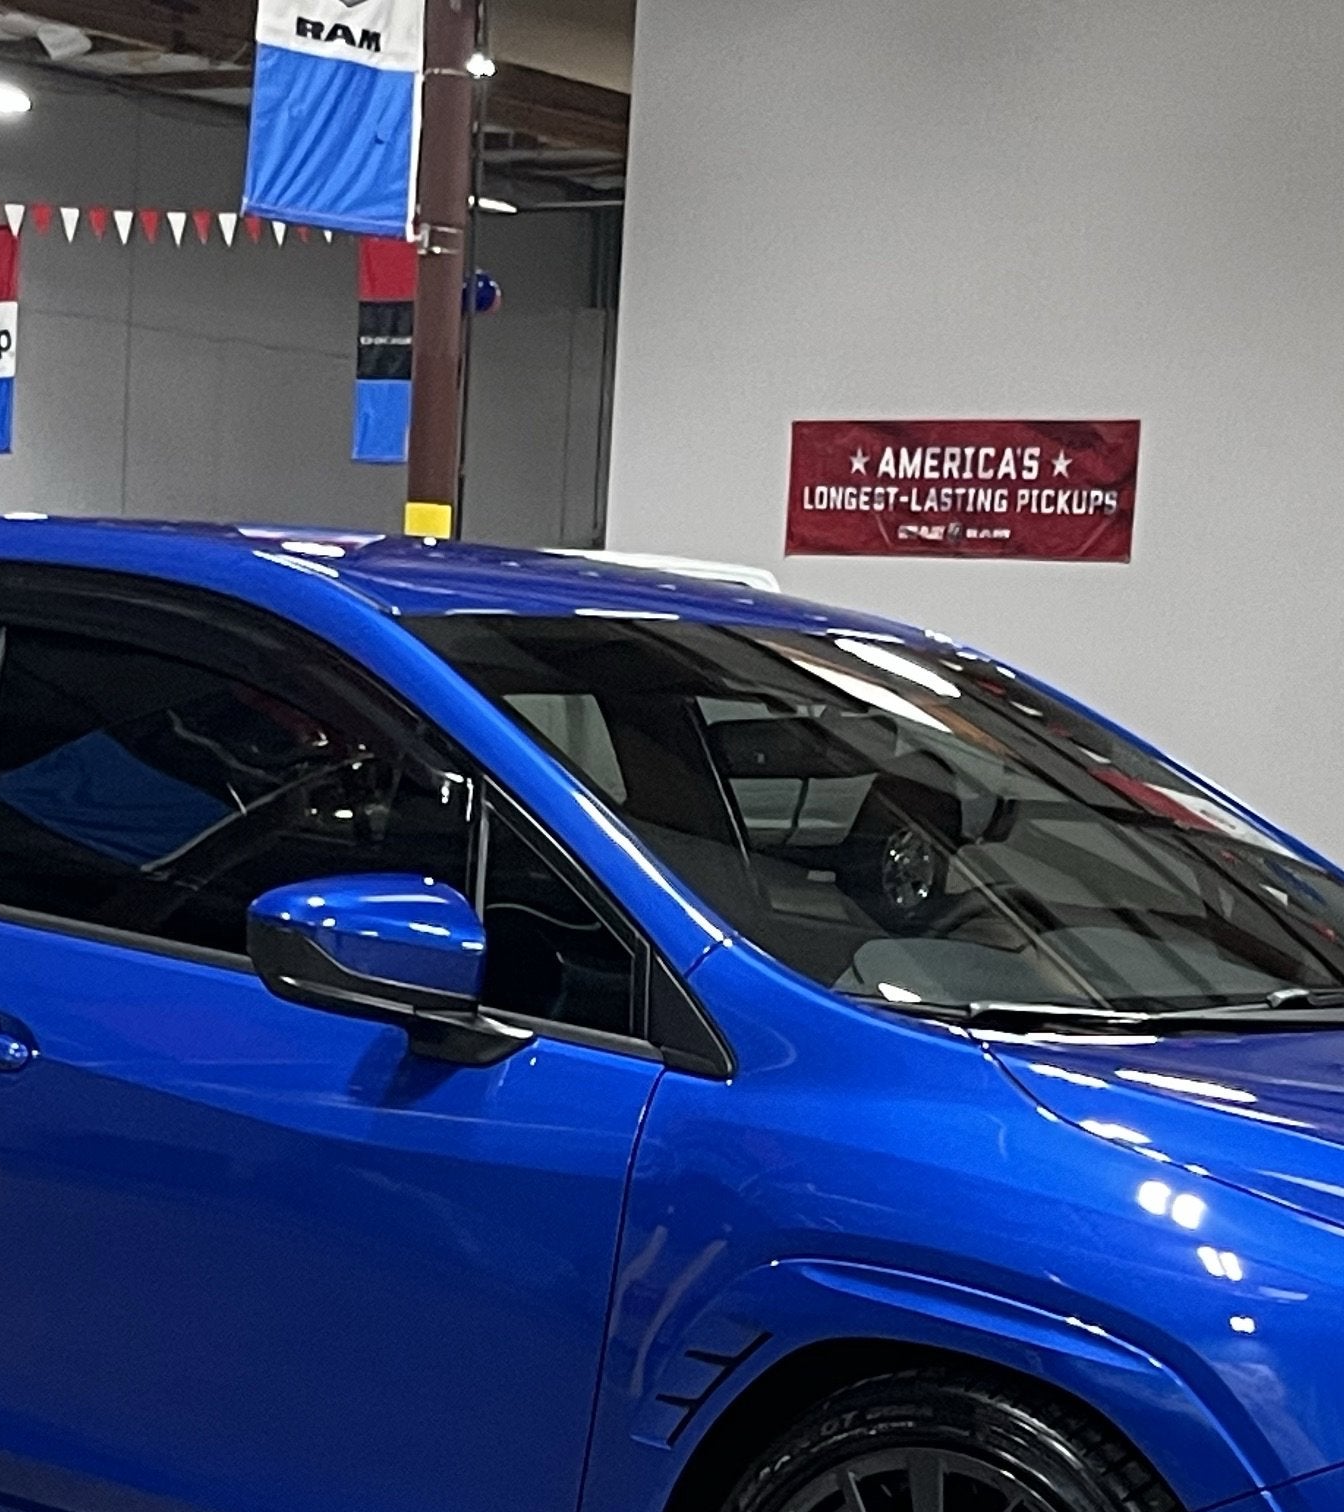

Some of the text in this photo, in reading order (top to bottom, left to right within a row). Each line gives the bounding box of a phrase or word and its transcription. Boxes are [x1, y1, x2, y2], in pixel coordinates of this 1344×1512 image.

[296, 16, 381, 53] RAM
[876, 446, 1041, 480] AMERICA'S
[803, 485, 1118, 515] LONGEST-LASTING PICKUPS
